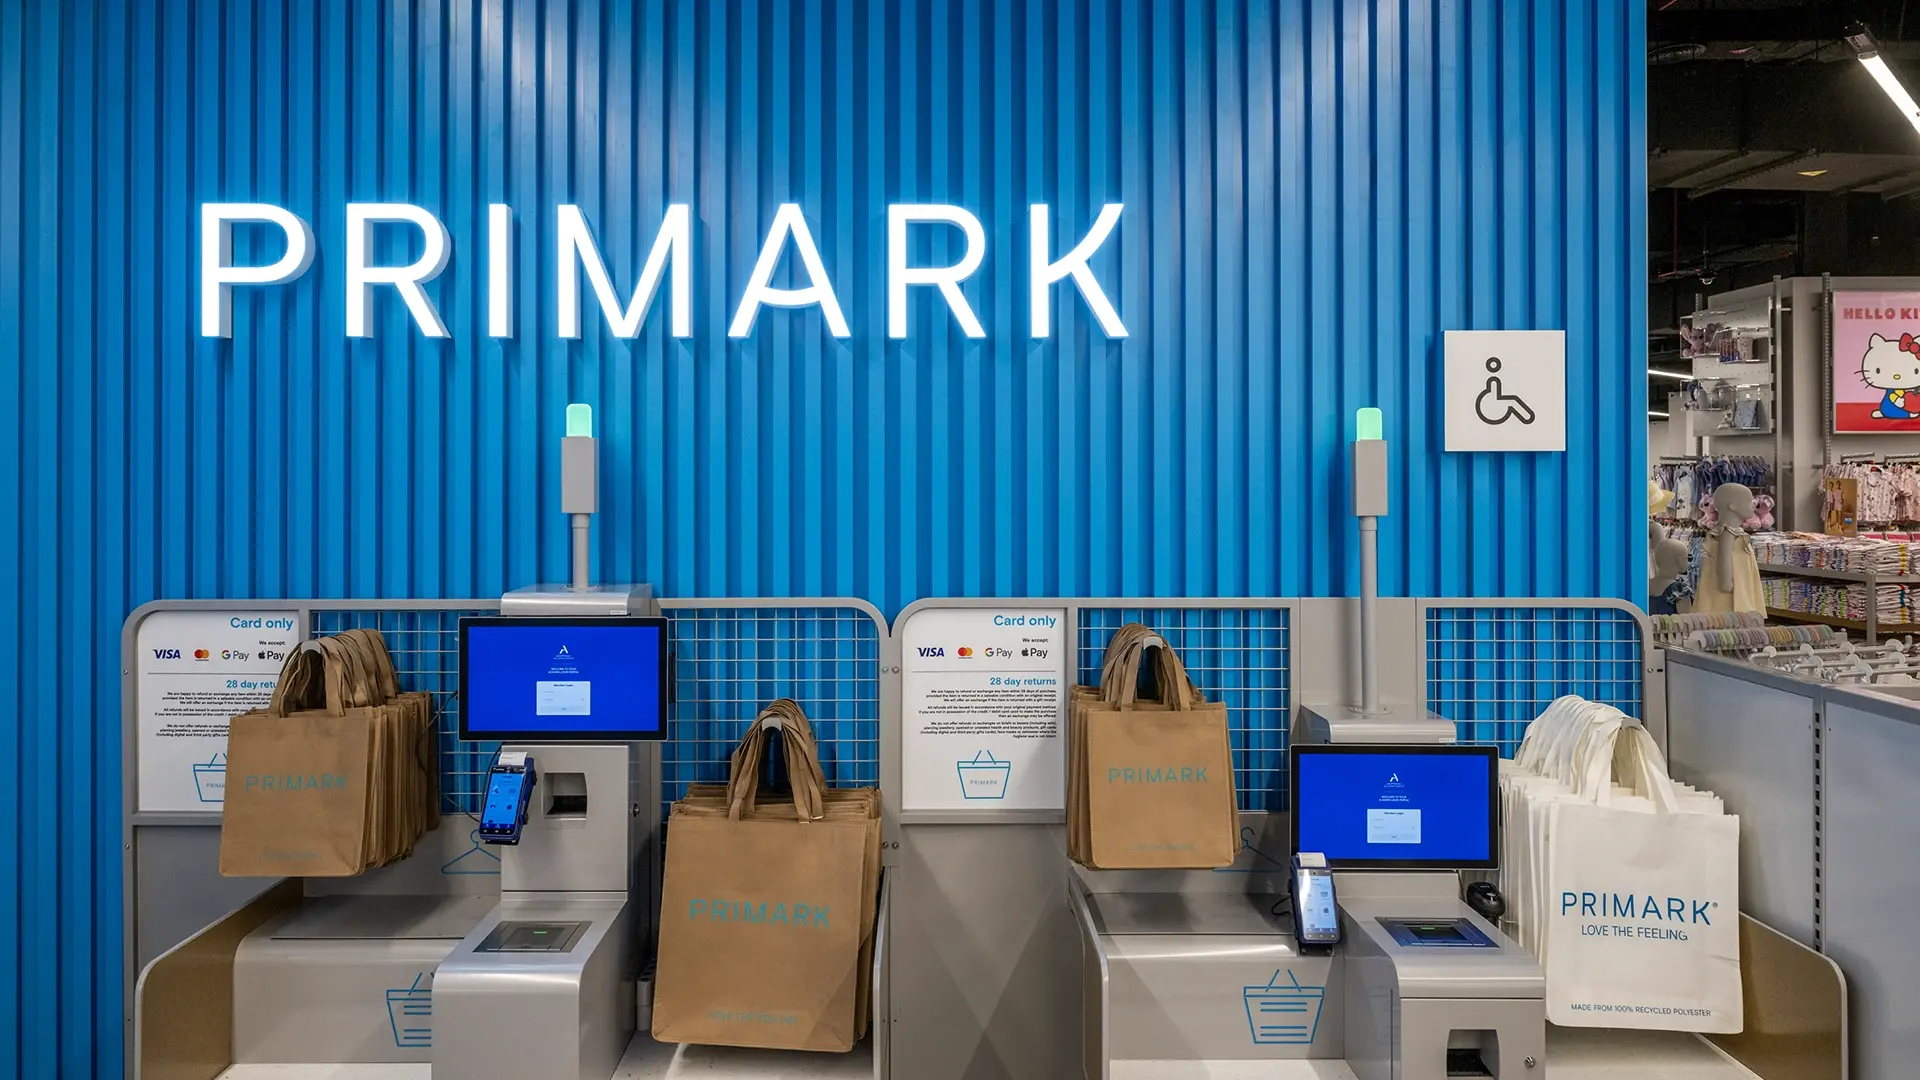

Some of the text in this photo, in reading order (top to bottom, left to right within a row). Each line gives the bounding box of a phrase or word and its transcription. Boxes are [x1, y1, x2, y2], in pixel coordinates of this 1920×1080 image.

[201, 202, 1130, 339] PRIMARK
[1843, 307, 1920, 320] HELLO KI
[230, 616, 293, 631] Card only
[994, 615, 1056, 628] Card only
[153, 649, 181, 659] VISA
[233, 650, 250, 661] Pay
[267, 650, 285, 661] Pay
[916, 647, 945, 657] VISA
[996, 648, 1013, 659] Pay
[1030, 648, 1048, 659] Pay
[226, 680, 237, 688] 28
[240, 680, 258, 690] day
[989, 678, 1001, 686] 28
[1004, 678, 1021, 687] day
[1108, 766, 1209, 784] PRIMARK
[245, 773, 348, 792] PRIMARK
[688, 898, 832, 930] PRIMARK
[1581, 925, 1688, 941] LOVE THE FEELING
[1635, 1006, 1671, 1015] RECYCLED
[1673, 1008, 1711, 1016] POLYESTER
[708, 1010, 797, 1025] LOVE THE FEELING
